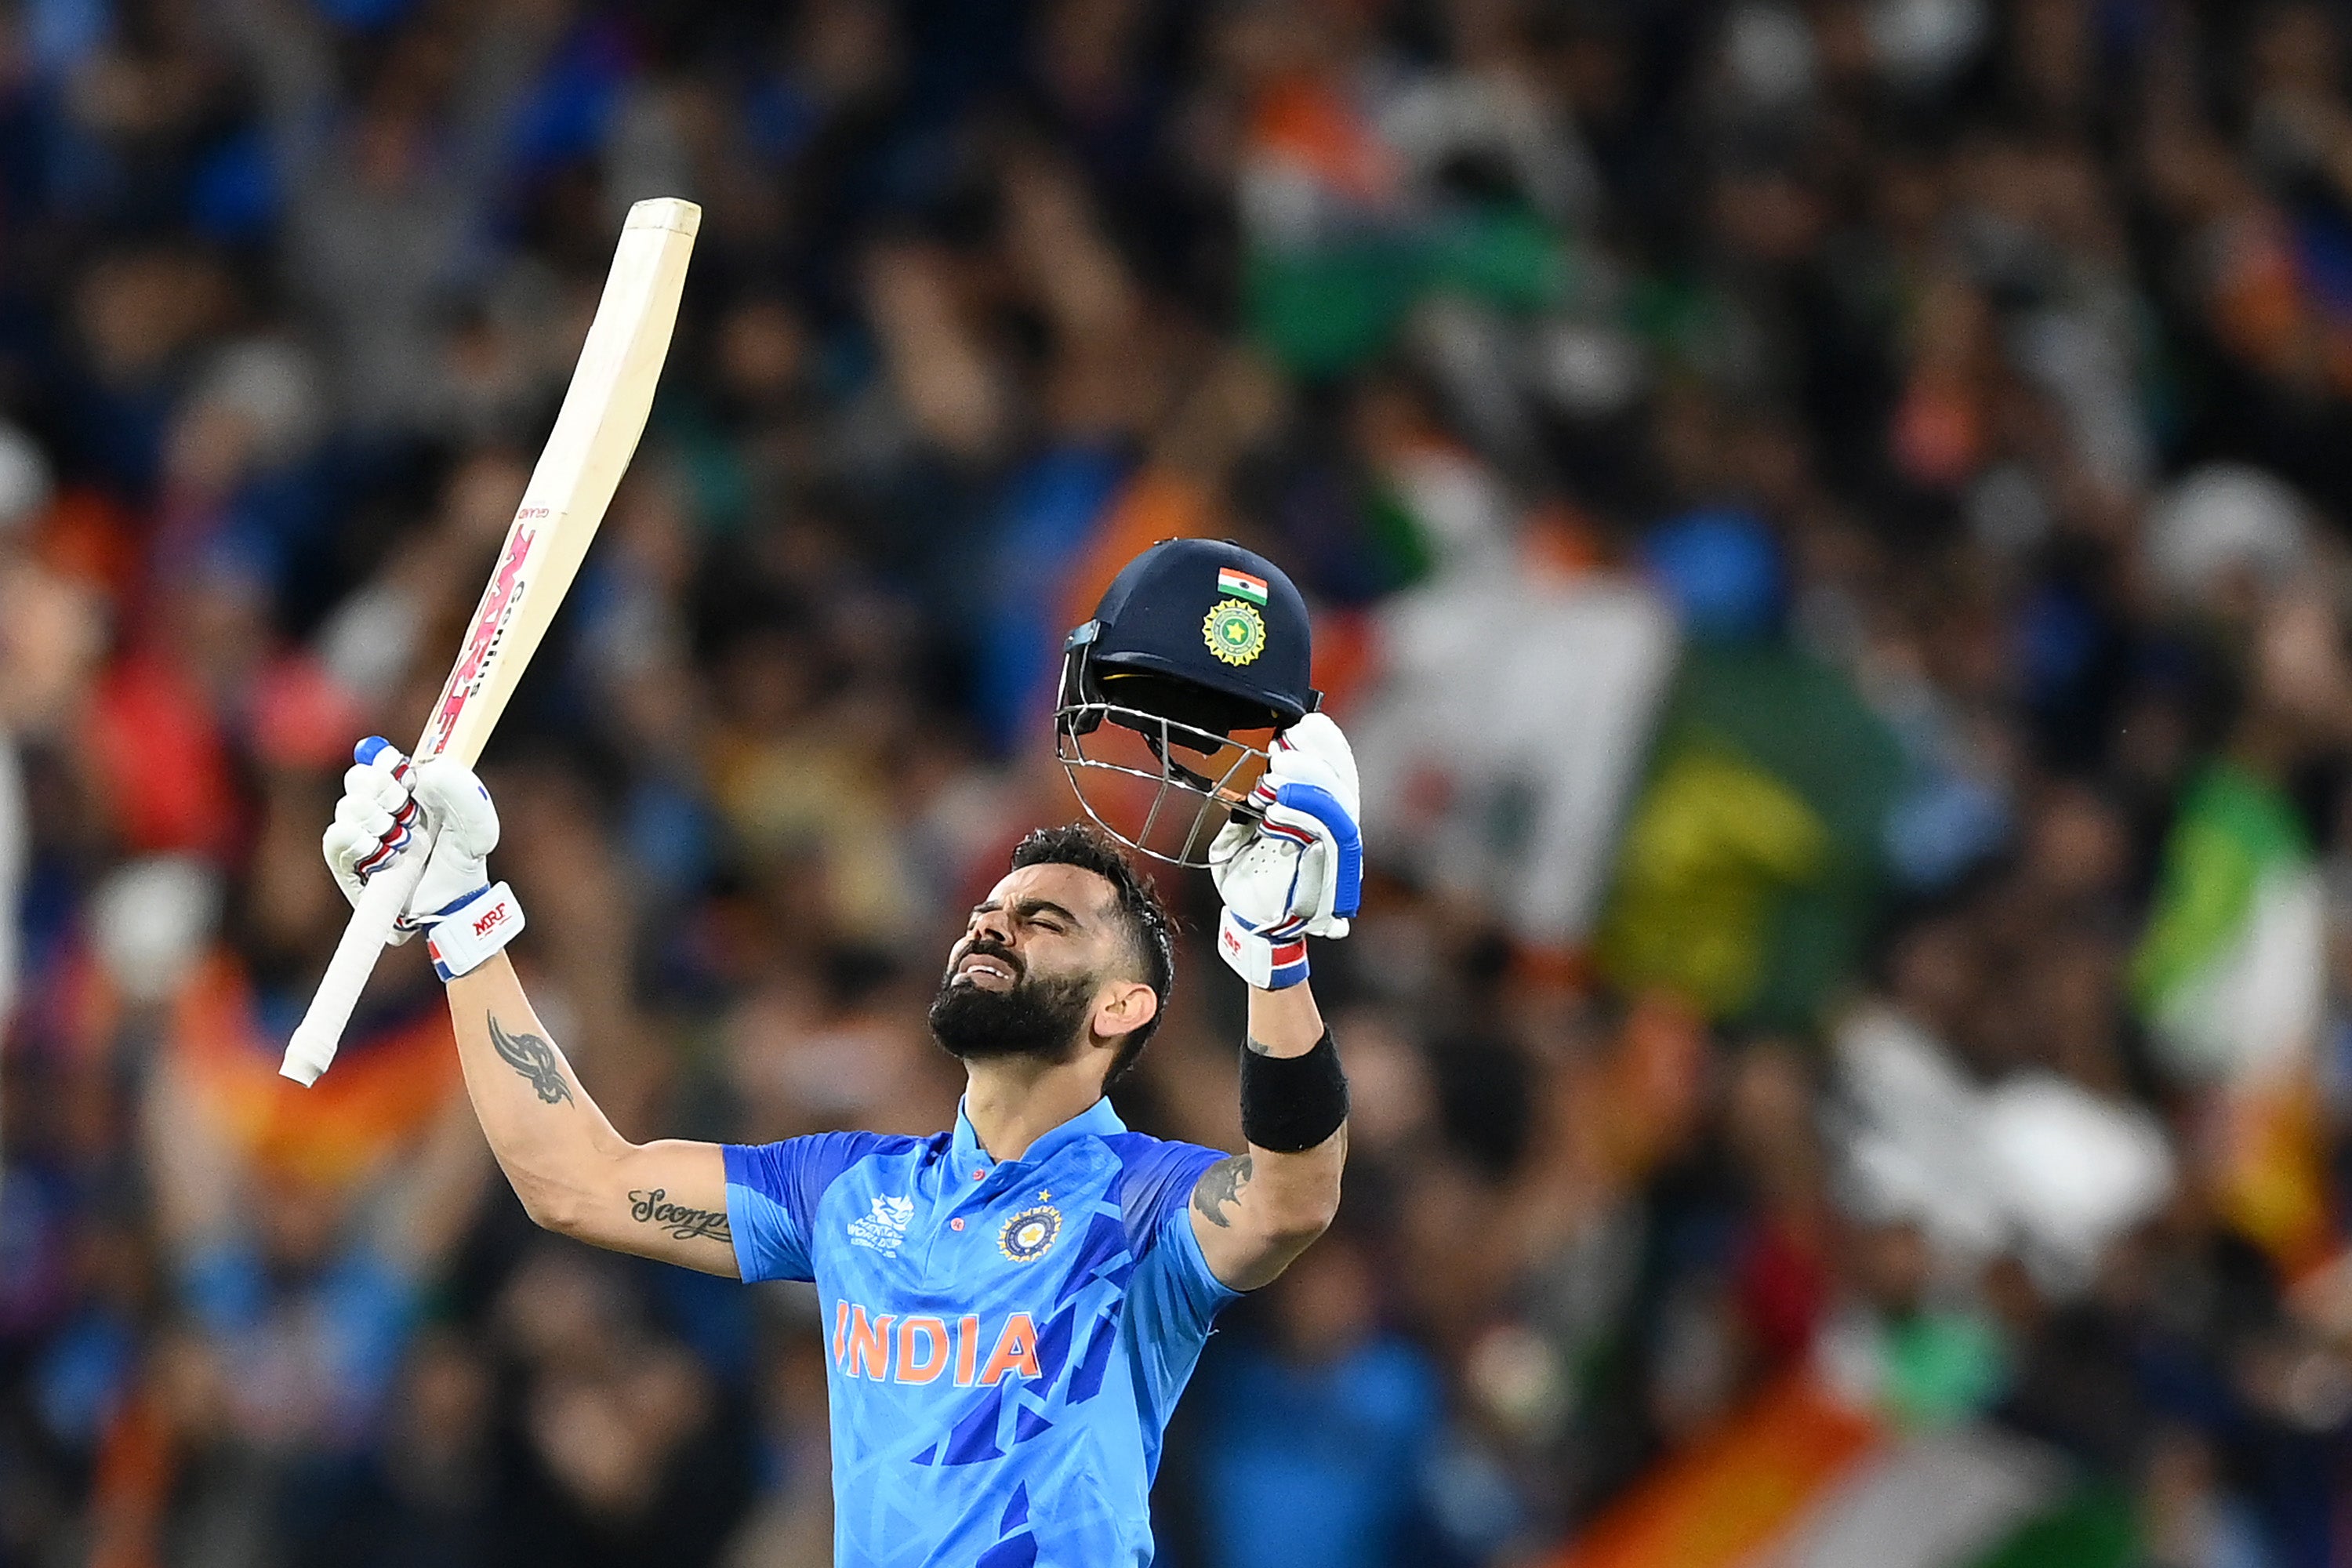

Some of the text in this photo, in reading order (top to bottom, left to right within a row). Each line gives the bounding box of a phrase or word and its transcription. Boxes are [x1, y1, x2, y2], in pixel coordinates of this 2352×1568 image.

[434, 524, 536, 754] MRF
[470, 581, 525, 697] Genius
[472, 902, 506, 936] MRF
[628, 1189, 731, 1241] Scorp
[833, 1298, 1043, 1388] INDIA
